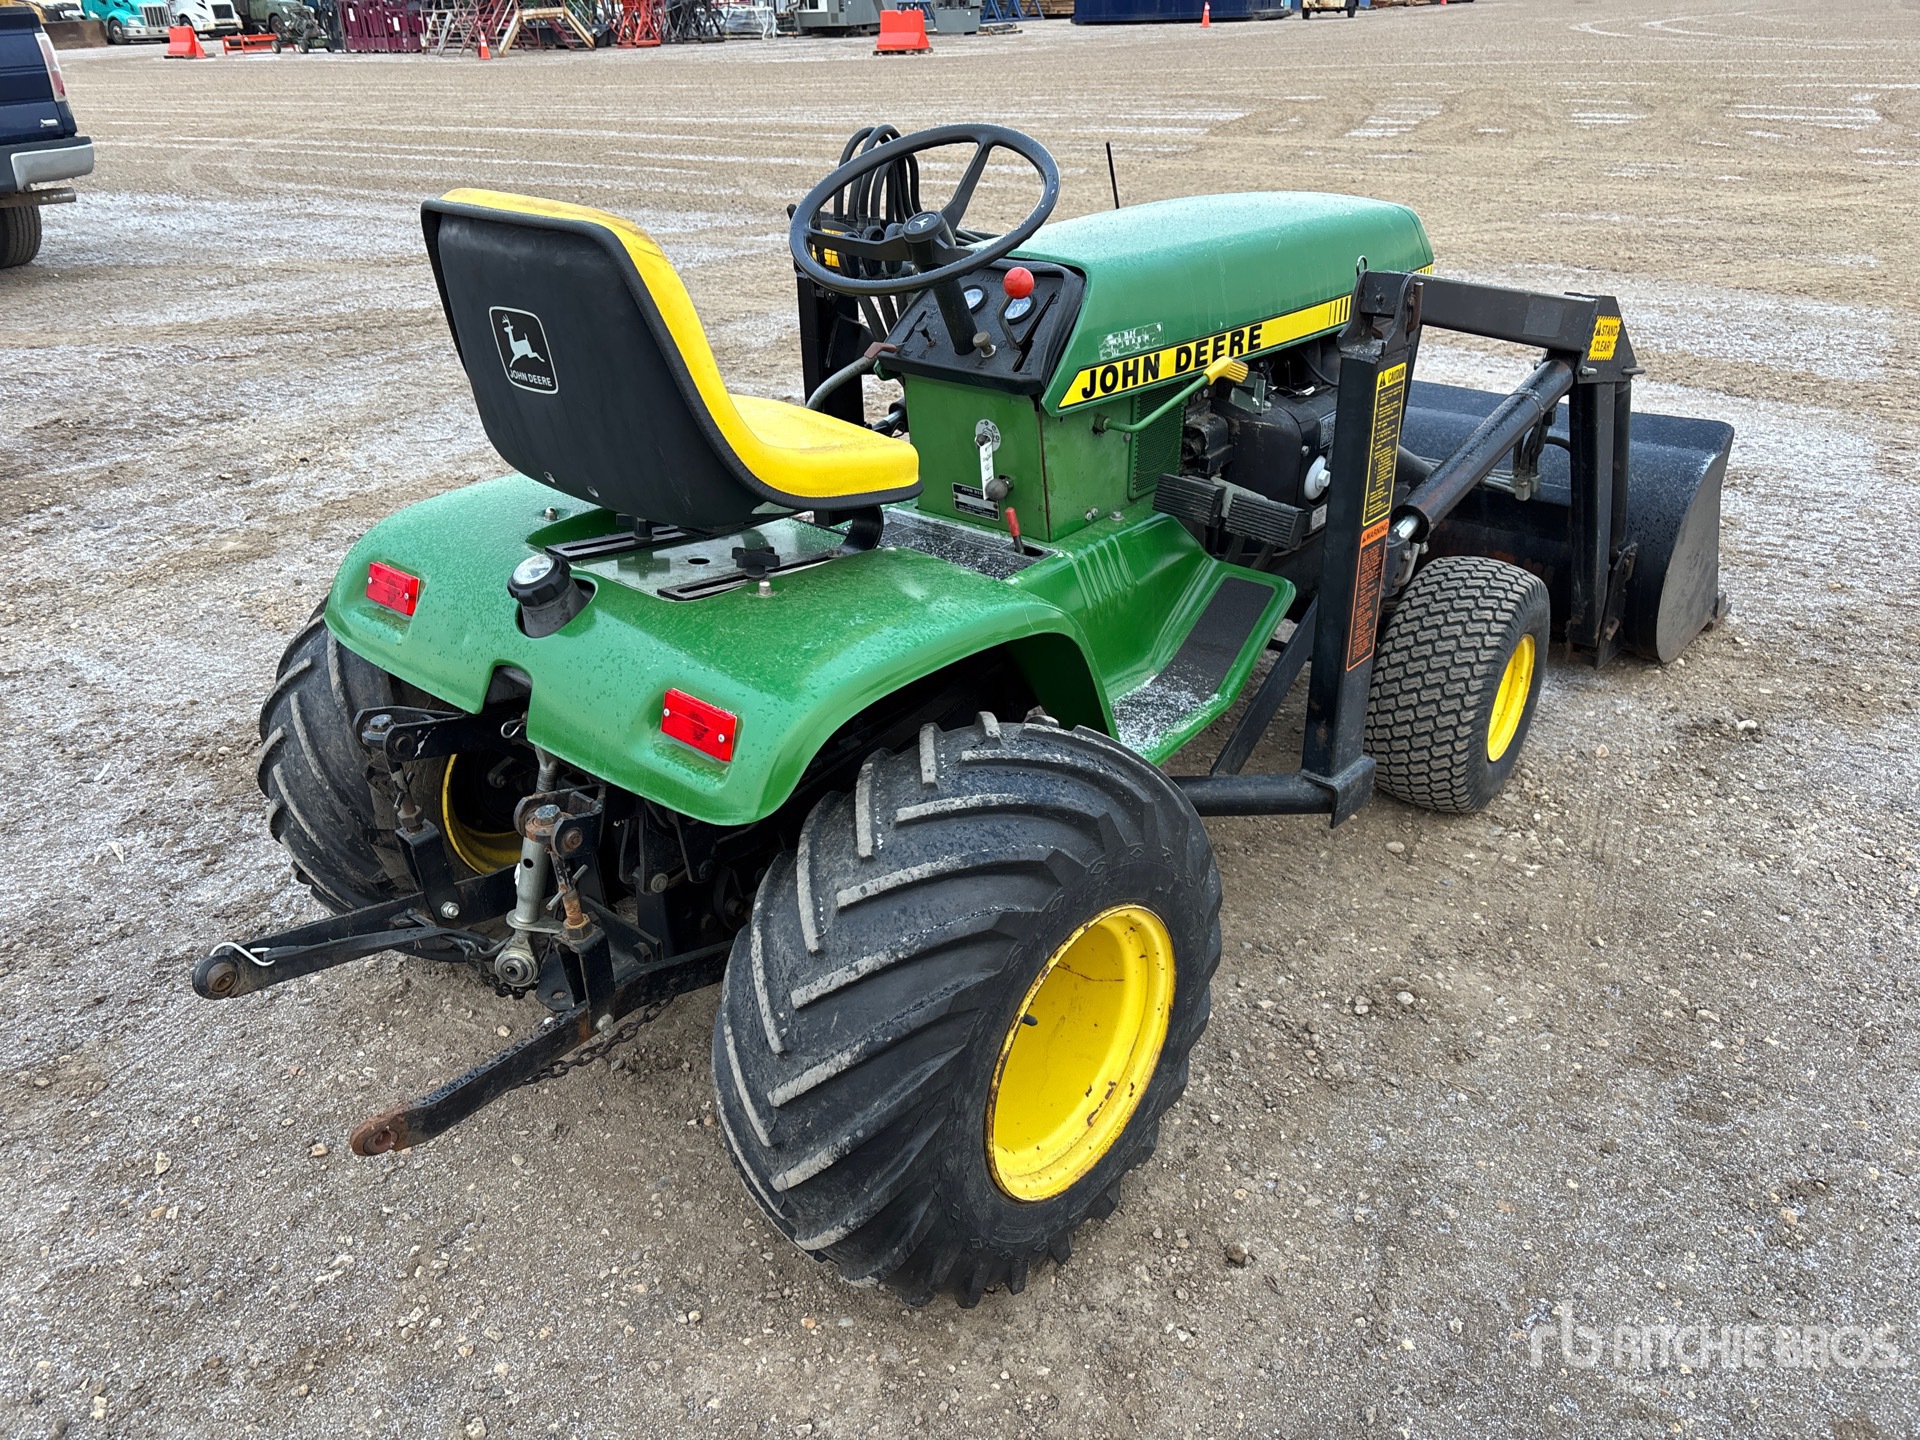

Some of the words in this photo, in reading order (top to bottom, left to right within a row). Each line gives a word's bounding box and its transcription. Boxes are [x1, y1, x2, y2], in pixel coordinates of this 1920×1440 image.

[1601, 325, 1618, 336] STAND
[1081, 353, 1160, 399] JOHN
[1175, 323, 1263, 374] DEERE
[510, 369, 528, 382] JOHN
[528, 373, 552, 386] DEERE
[1388, 366, 1405, 384] CAUTION
[1366, 522, 1389, 540] WARNING
